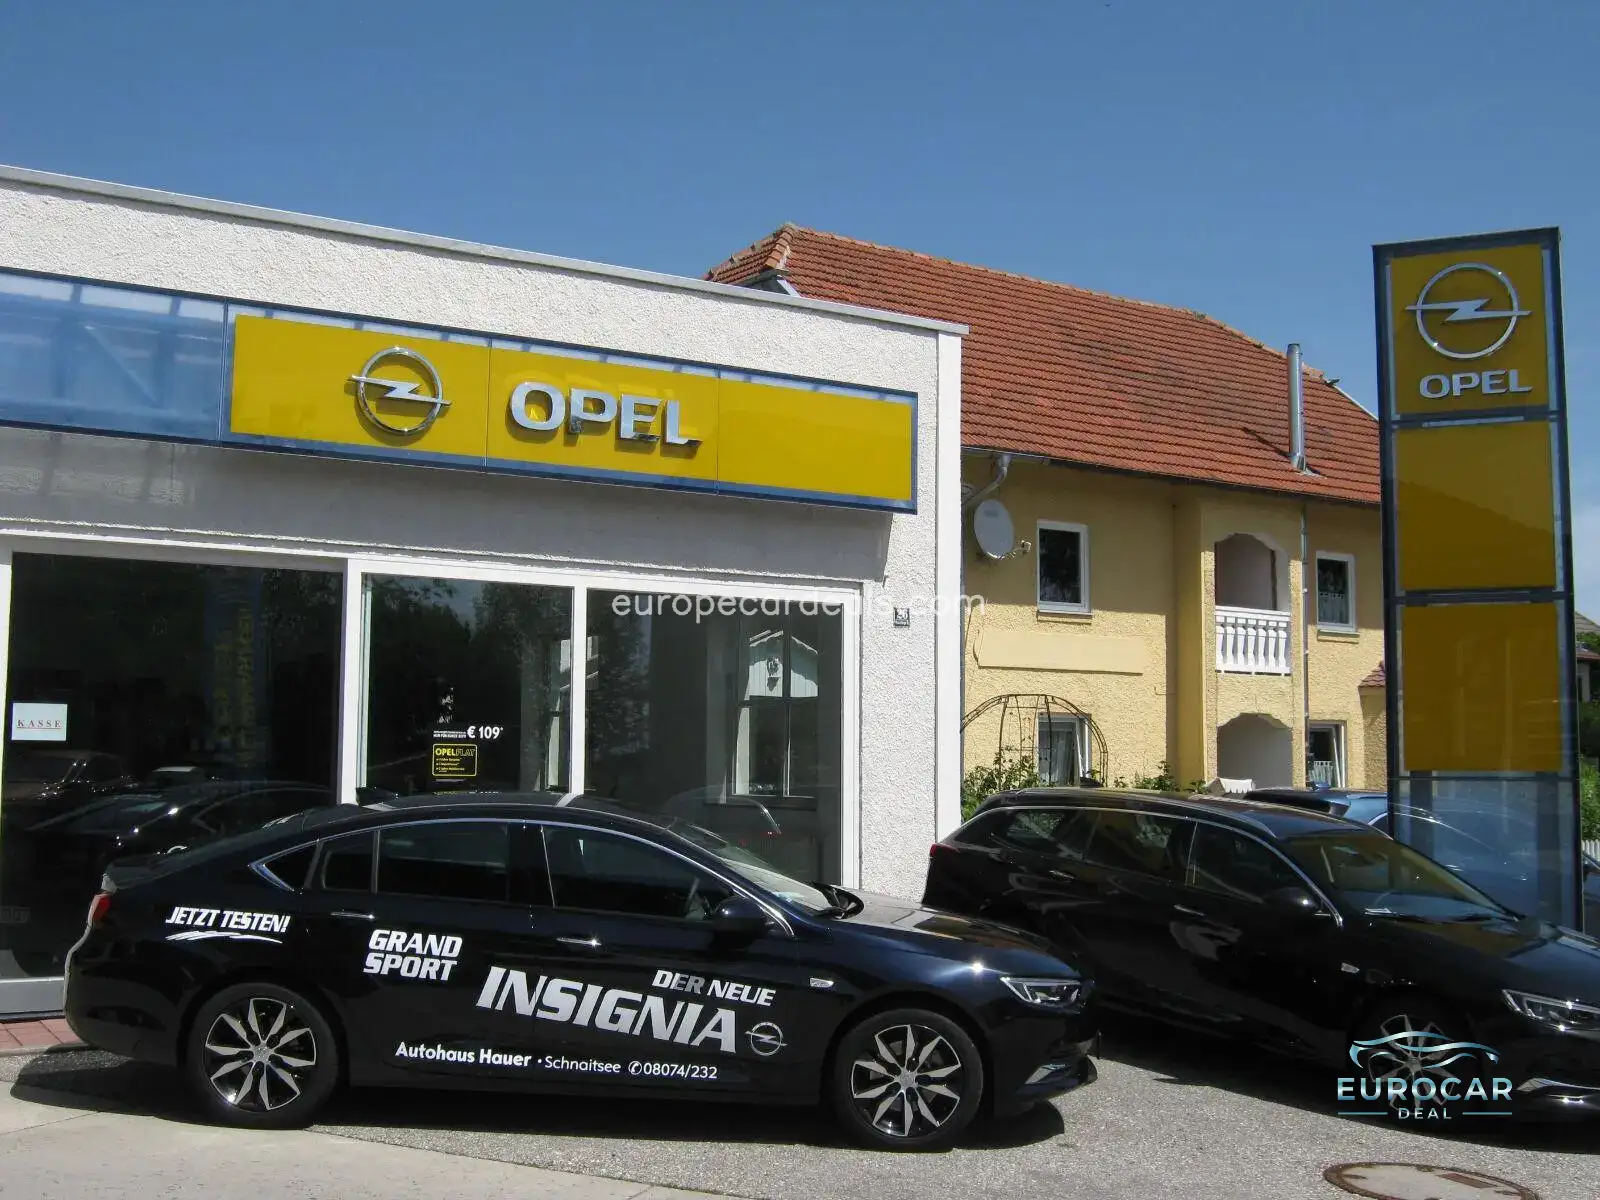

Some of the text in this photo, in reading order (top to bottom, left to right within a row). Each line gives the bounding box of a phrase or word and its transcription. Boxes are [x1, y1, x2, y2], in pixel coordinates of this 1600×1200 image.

[1419, 369, 1533, 399] OPEL
[510, 381, 702, 446] OPEL
[17, 719, 63, 729] KASSE
[165, 906, 291, 933] JETZT TESTEN!
[368, 929, 463, 957] GRAND
[363, 952, 458, 982] SPORT
[652, 969, 777, 1007] DER NEUE
[475, 965, 737, 1054] INSIGNIA
[395, 1041, 475, 1064] Autohaus
[479, 1047, 532, 1068] Hauer
[544, 1055, 621, 1074] Schnaitsee
